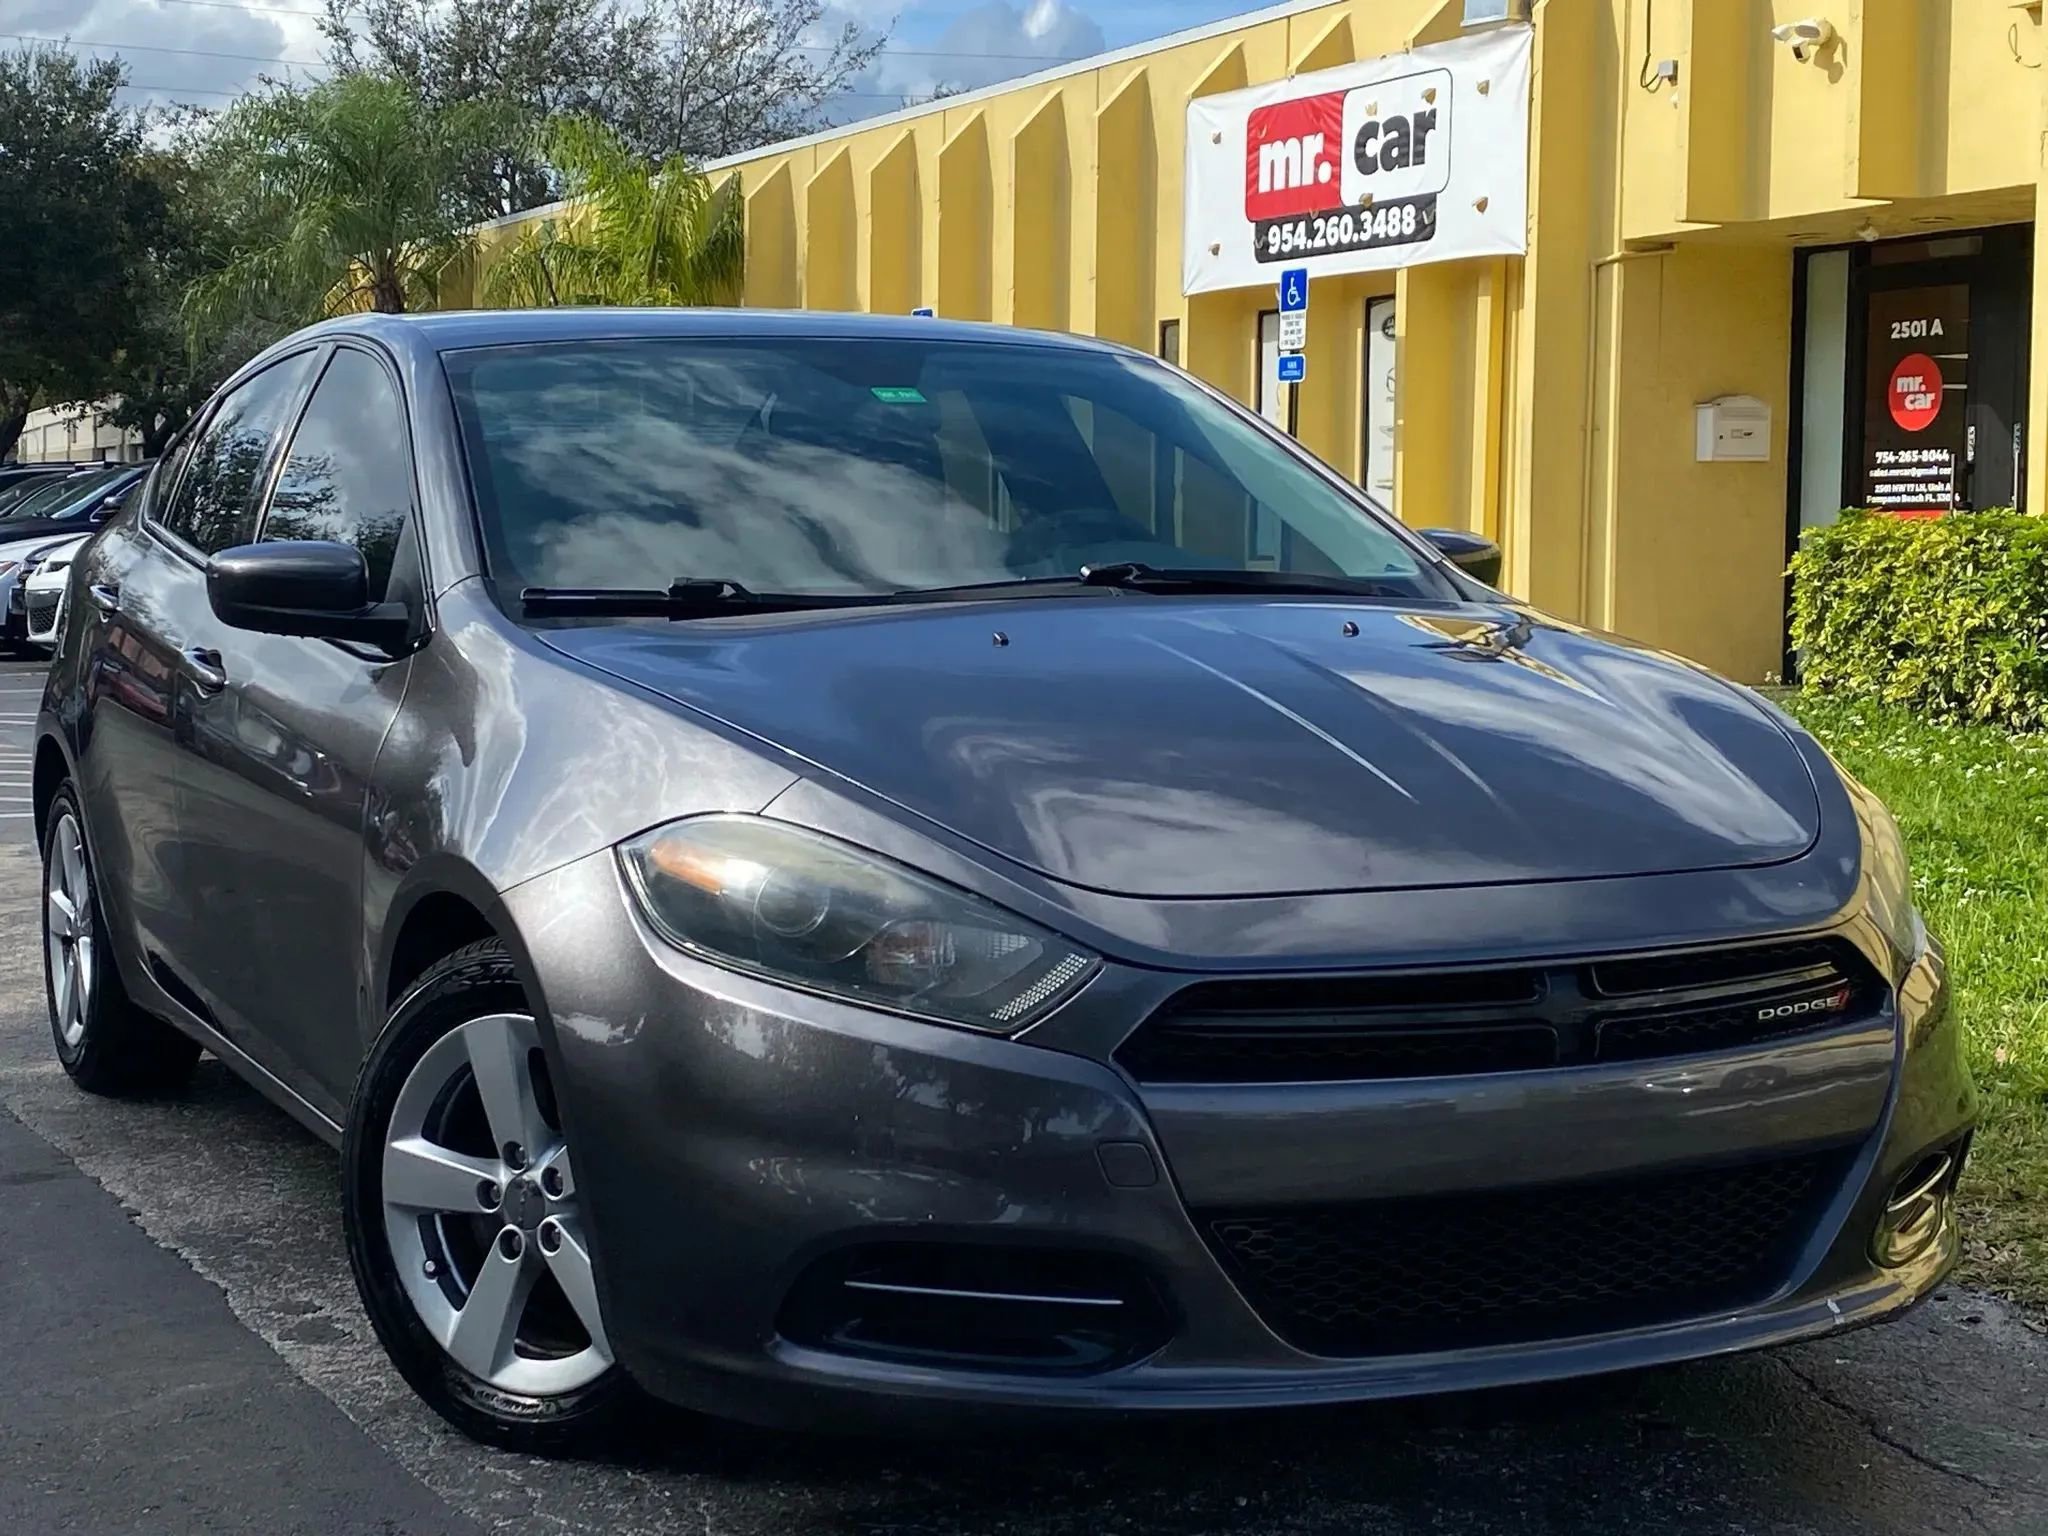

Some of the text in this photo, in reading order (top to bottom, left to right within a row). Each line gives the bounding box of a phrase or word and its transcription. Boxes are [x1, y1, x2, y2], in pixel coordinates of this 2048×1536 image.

[1258, 107, 1437, 194] mr. car
[1267, 203, 1416, 254] 954.260.3488
[1890, 318, 1944, 339] 2501 A
[1896, 375, 1926, 393] mr.
[1904, 393, 1936, 411] car
[1875, 449, 1950, 464] 754-265-8044
[1758, 995, 1840, 1020] DODGE
